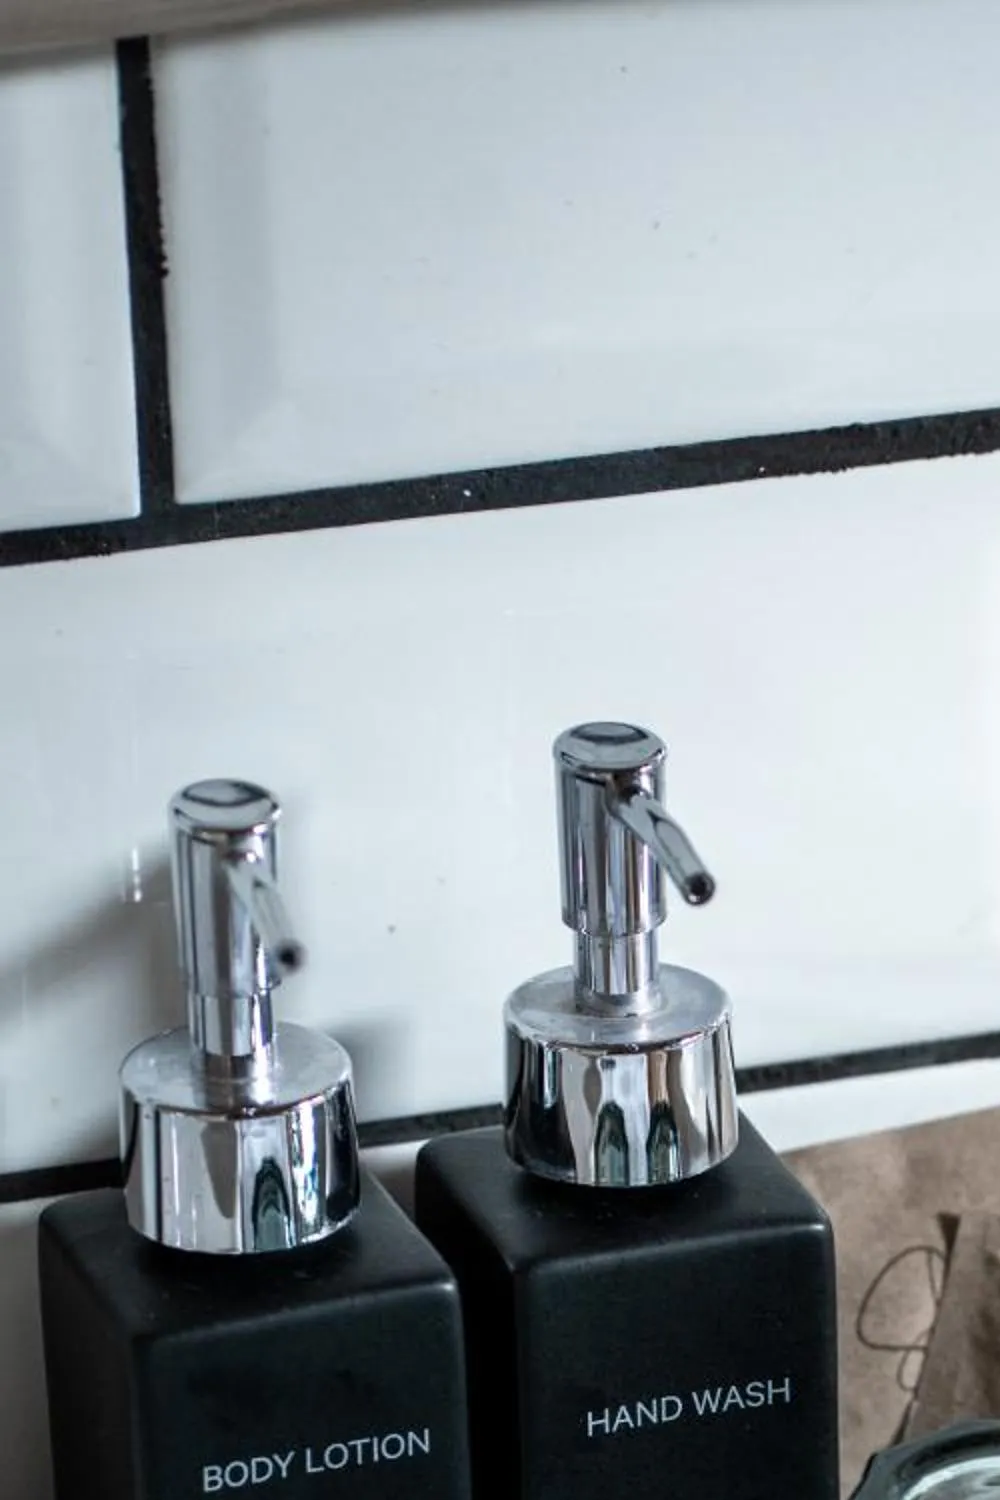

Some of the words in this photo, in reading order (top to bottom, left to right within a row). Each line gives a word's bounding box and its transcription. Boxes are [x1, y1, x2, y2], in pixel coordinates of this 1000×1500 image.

[586, 1396, 684, 1437] HAND
[691, 1377, 791, 1416] WASH
[202, 1450, 296, 1493] BODY
[305, 1428, 431, 1473] LOTION
